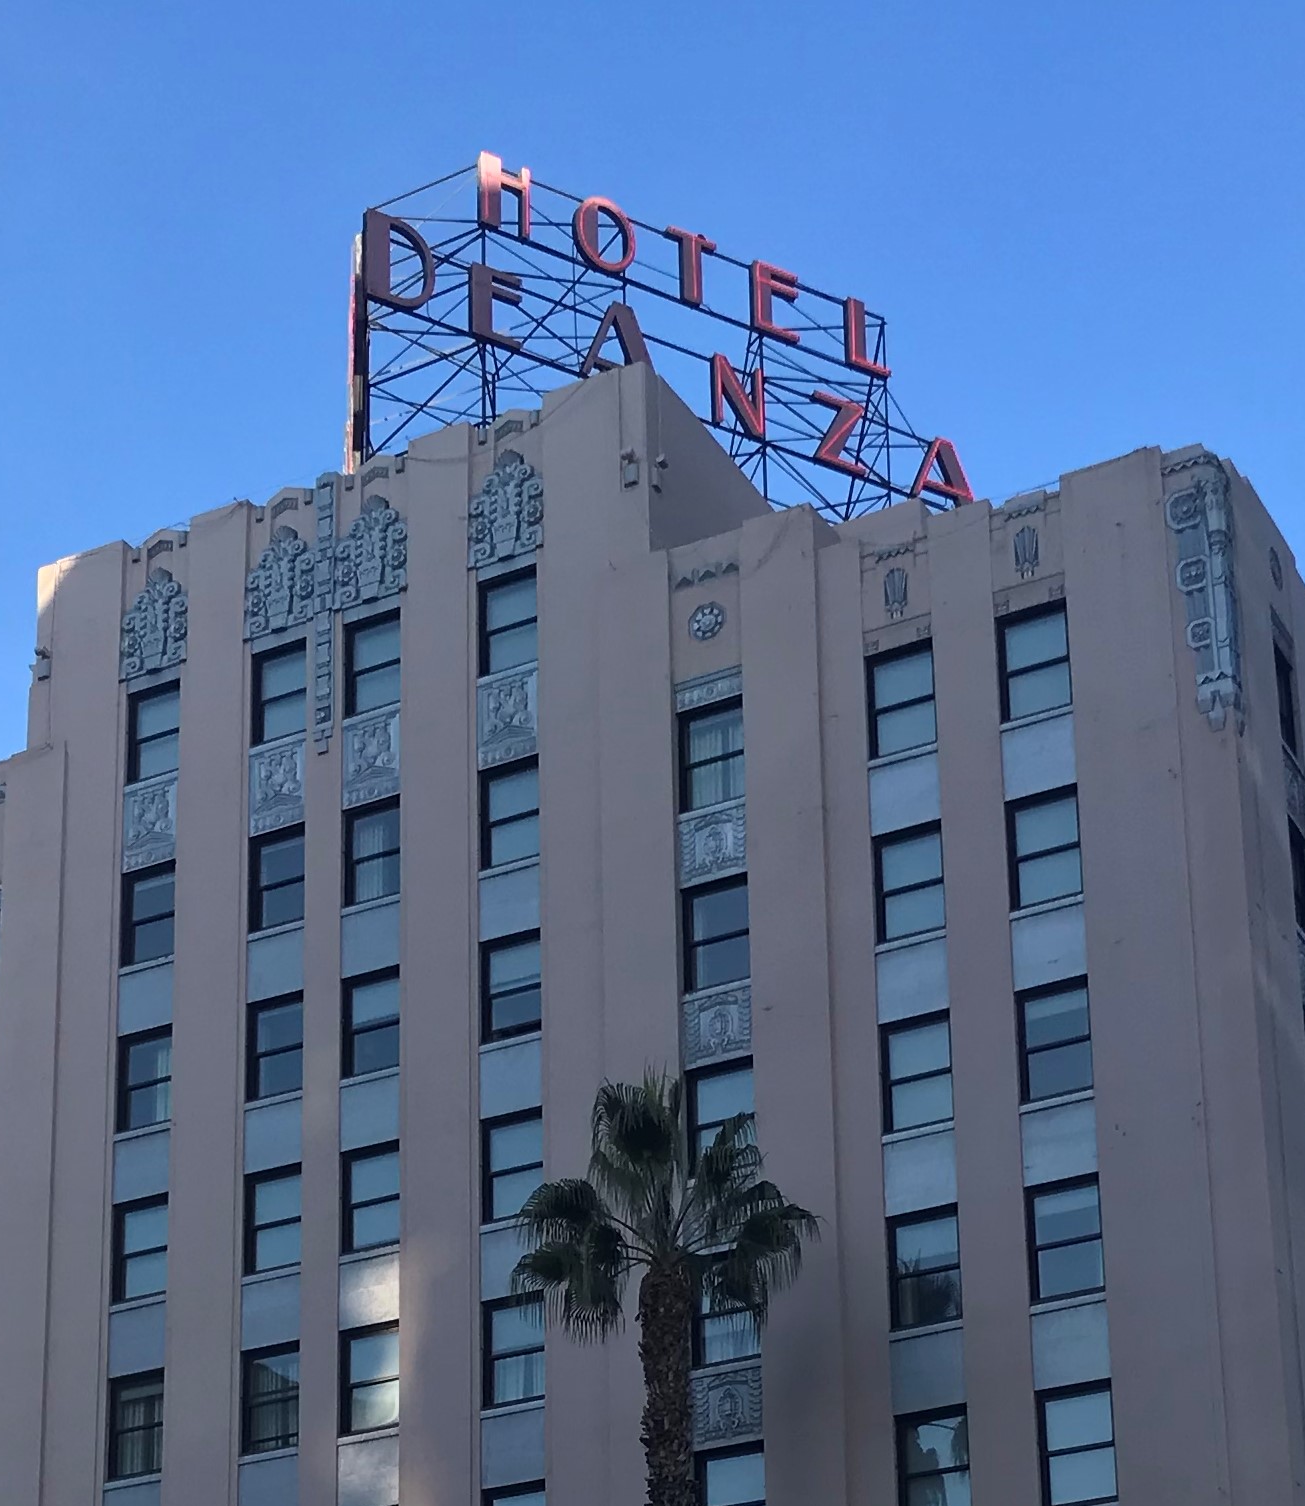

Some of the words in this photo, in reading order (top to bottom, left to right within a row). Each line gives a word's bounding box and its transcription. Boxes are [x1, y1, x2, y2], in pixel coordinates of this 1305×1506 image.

[363, 209, 523, 350] DE
[581, 301, 974, 506] ANZA
[476, 151, 891, 378] HOTEL
